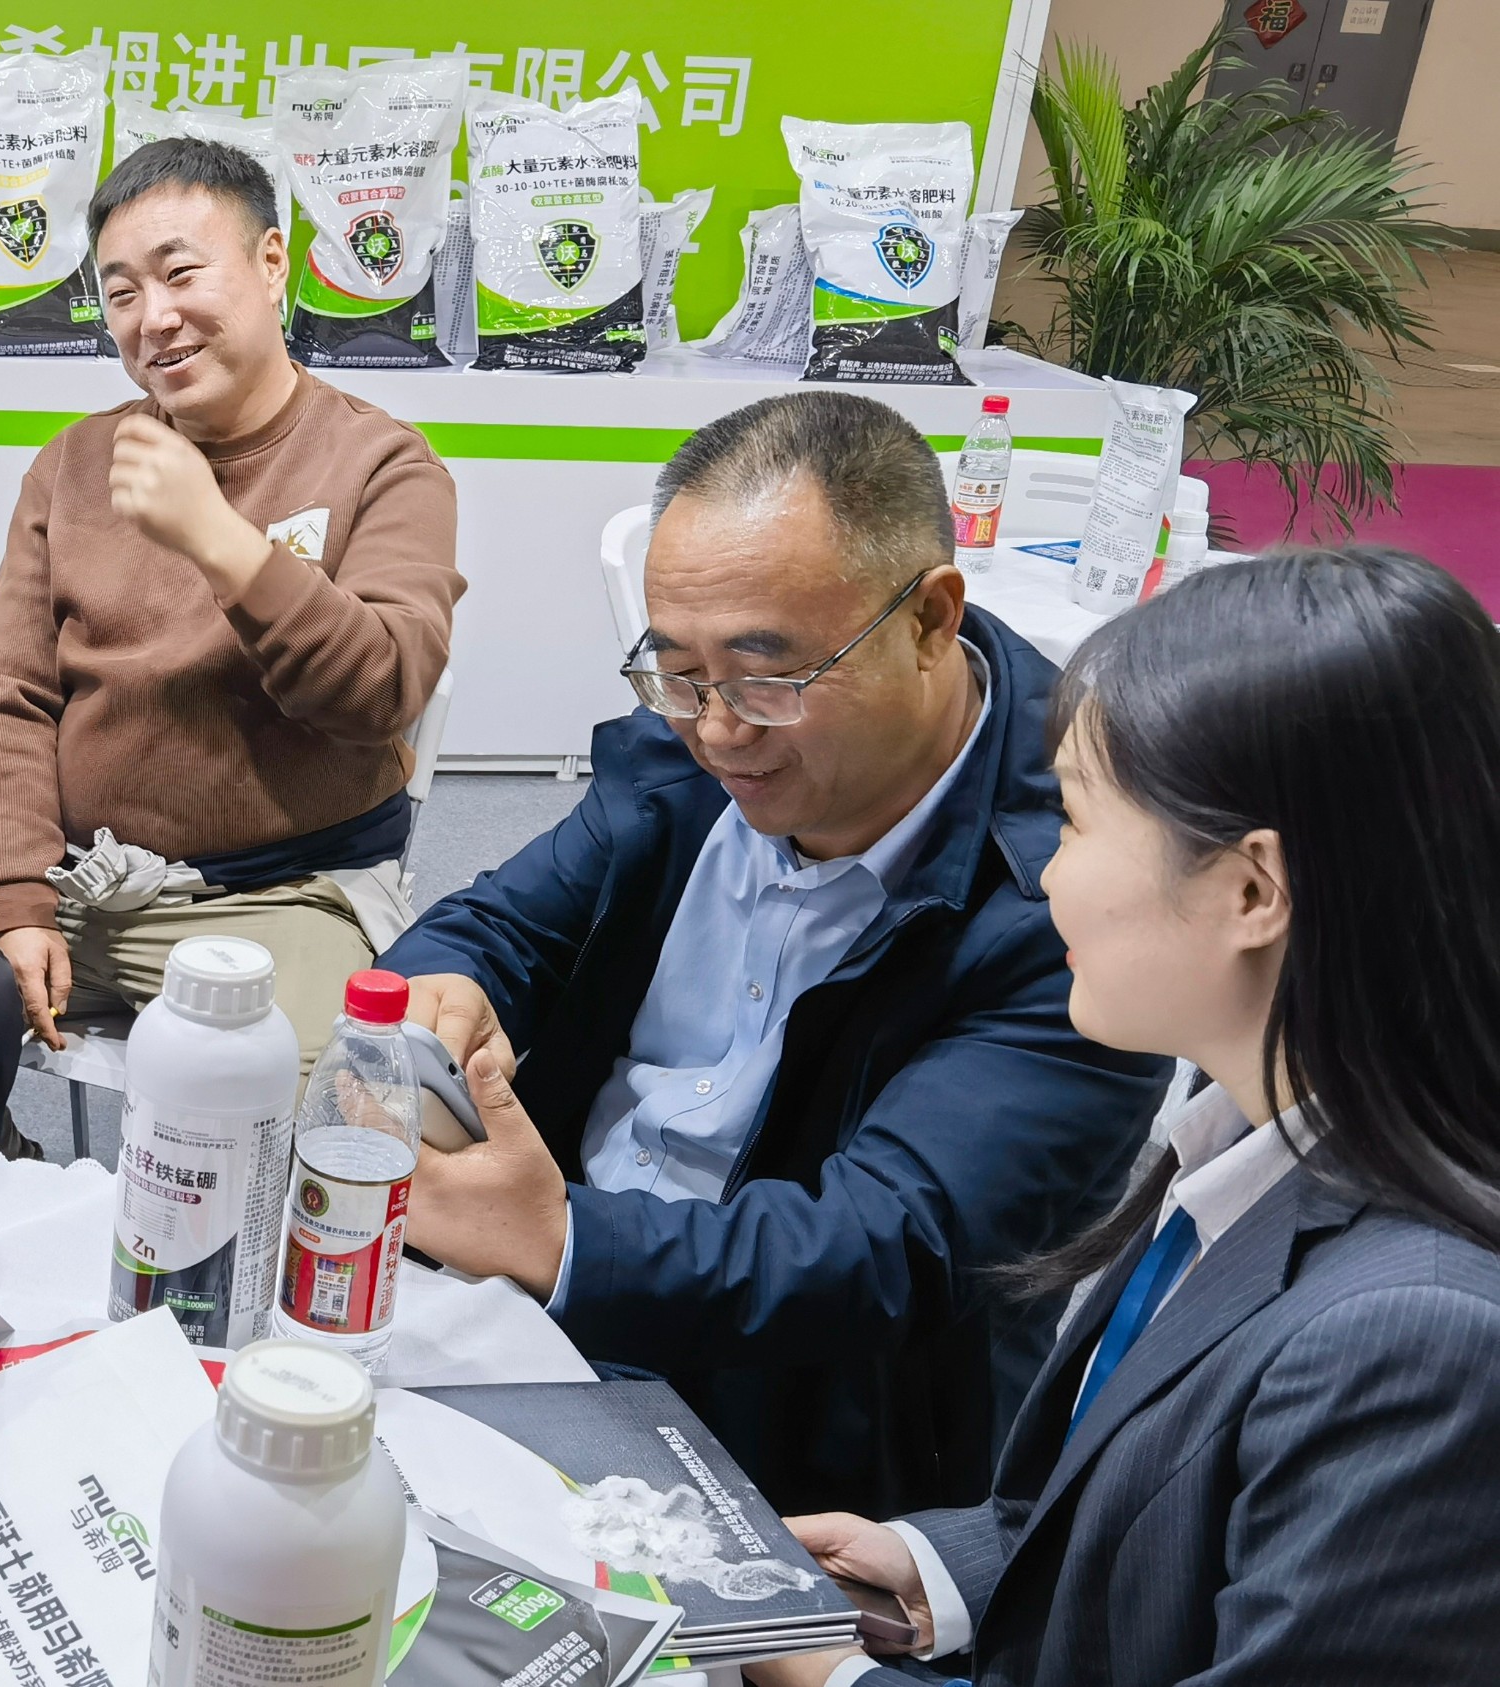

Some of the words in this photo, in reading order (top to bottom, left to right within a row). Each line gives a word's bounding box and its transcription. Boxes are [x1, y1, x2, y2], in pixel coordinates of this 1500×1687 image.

[301, 111, 334, 122] 马希姆
[506, 154, 639, 176] 大量元素水溶肥料
[560, 245, 577, 262] 沃
[120, 1140, 218, 1190] 合锌铁锰硼
[132, 1233, 156, 1261] Zn
[70, 1504, 125, 1574] 马希姆
[477, 1575, 522, 1606] 剂型：粉剂
[506, 1591, 558, 1625] 1000g
